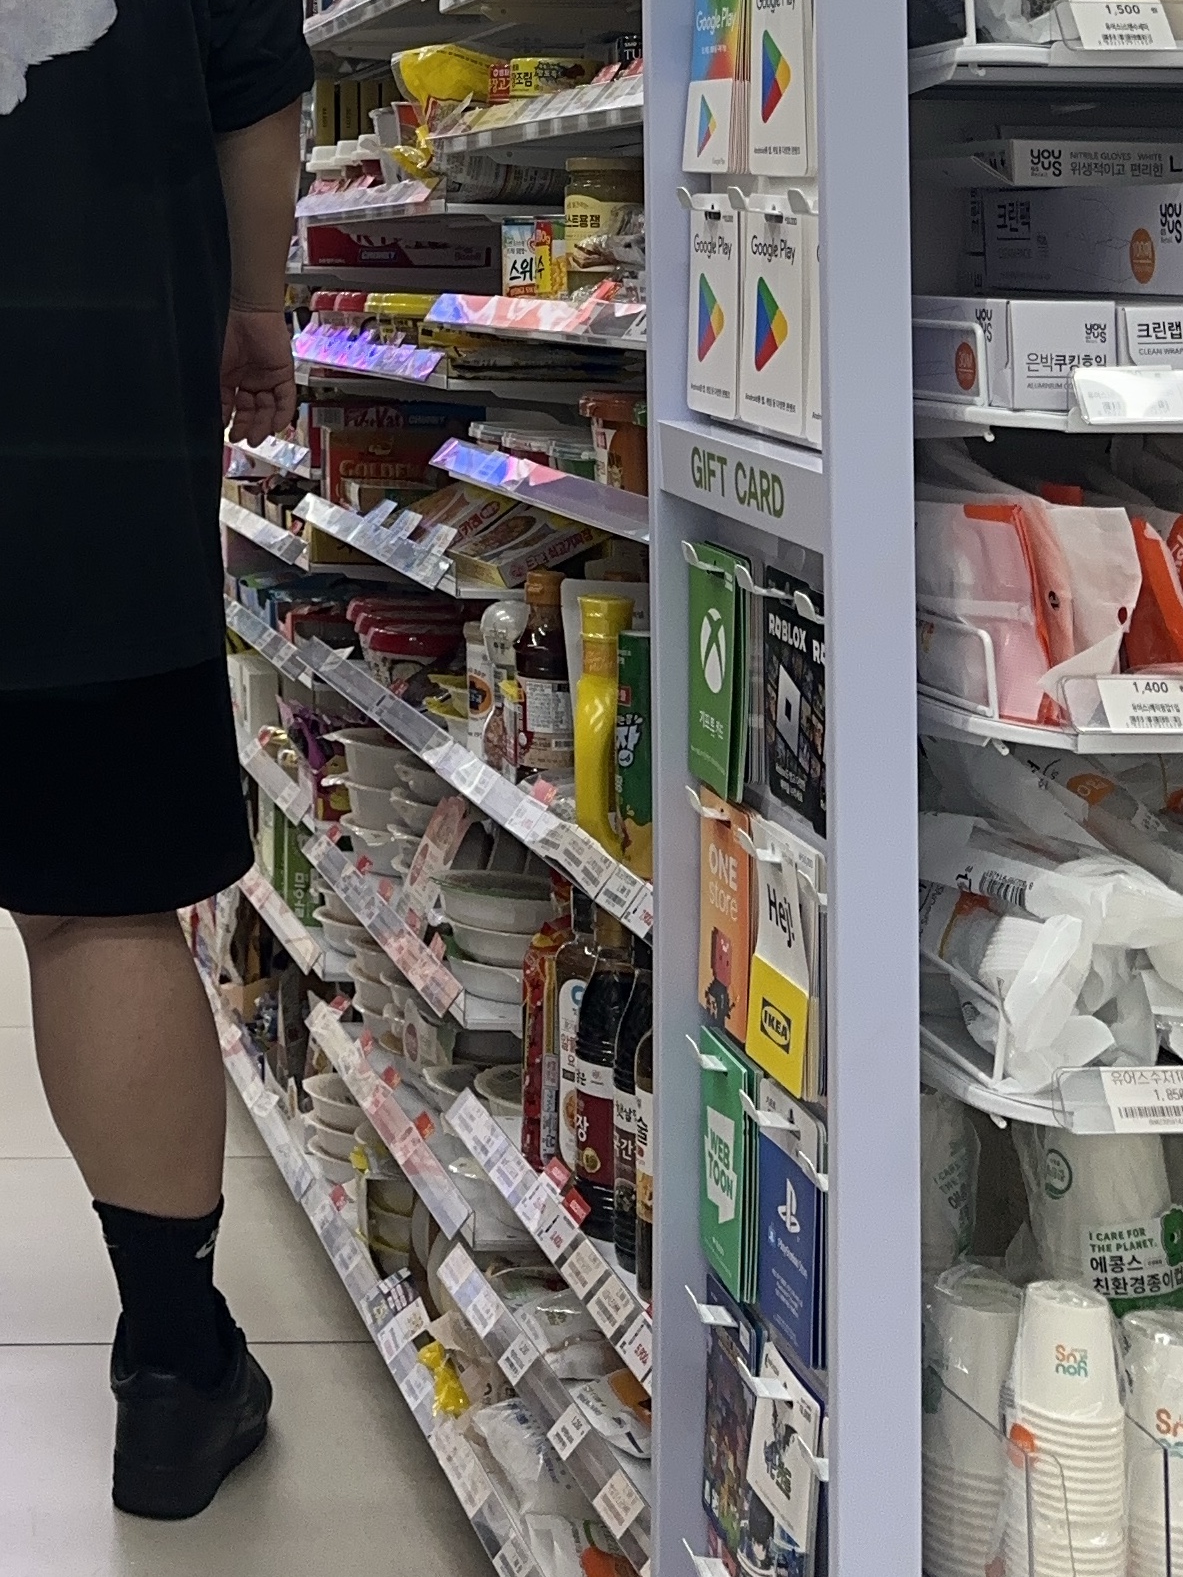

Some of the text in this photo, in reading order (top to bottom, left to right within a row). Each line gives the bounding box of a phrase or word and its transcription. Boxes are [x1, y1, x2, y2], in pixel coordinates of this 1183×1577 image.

[1105, 4, 1141, 16] 1,500
[1030, 148, 1062, 166] you
[1101, 152, 1132, 161] GLOVES
[1137, 153, 1163, 161] WHITE
[1070, 162, 1163, 178] 위생적이고 편리한
[1160, 202, 1182, 227] you
[693, 232, 733, 262] Google Play
[750, 233, 797, 266] Google Play
[1084, 322, 1107, 335] you
[1137, 321, 1183, 341] 크린랩
[690, 445, 786, 520] GIFT CARD
[768, 612, 808, 654] ROBLOX
[1132, 681, 1169, 695] 1,400
[707, 841, 739, 892] ONE
[707, 880, 739, 923] store
[766, 883, 795, 949] Hej!
[762, 1009, 790, 1043] IKEA
[709, 1127, 731, 1172] WEB
[707, 1156, 735, 1202] TOON
[1095, 1230, 1125, 1243] CARE
[1127, 1226, 1147, 1240] FOR
[1089, 1243, 1113, 1254] THE
[1089, 1254, 1144, 1274] 에콩스
